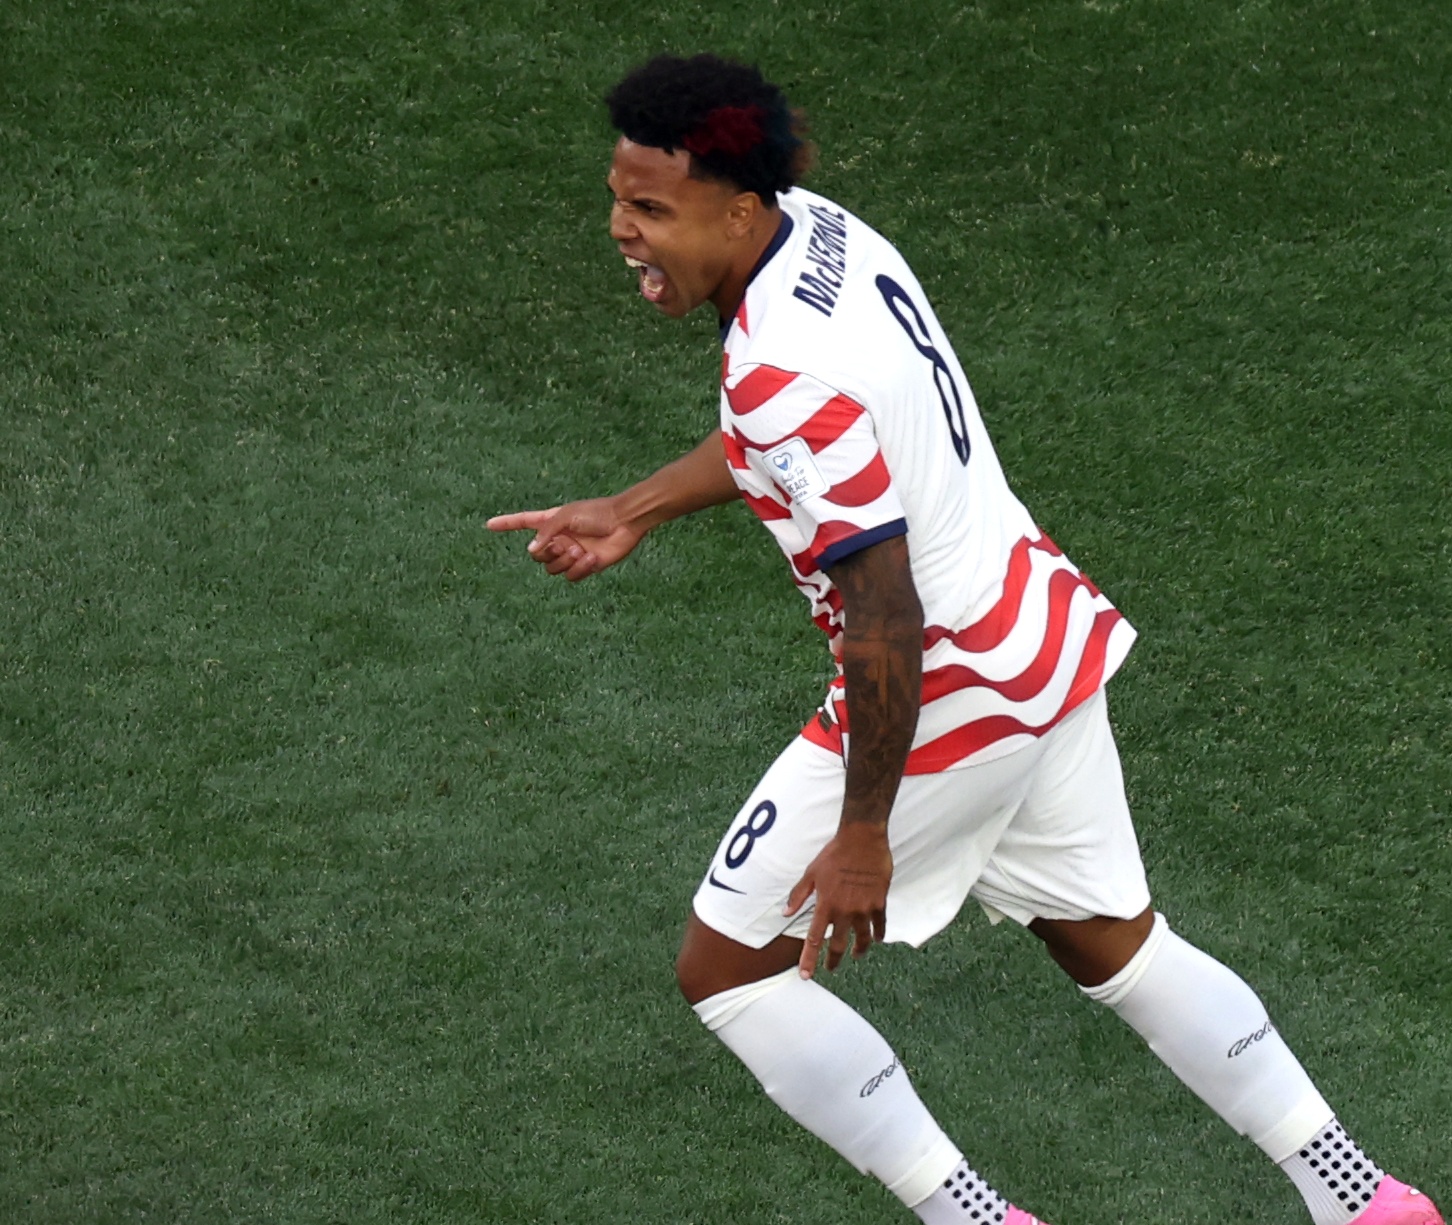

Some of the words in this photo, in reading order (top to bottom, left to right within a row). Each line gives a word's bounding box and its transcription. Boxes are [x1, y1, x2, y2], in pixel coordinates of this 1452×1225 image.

[792, 203, 847, 317] McKENNIE
[875, 274, 971, 466] 8
[725, 799, 777, 869] 8
